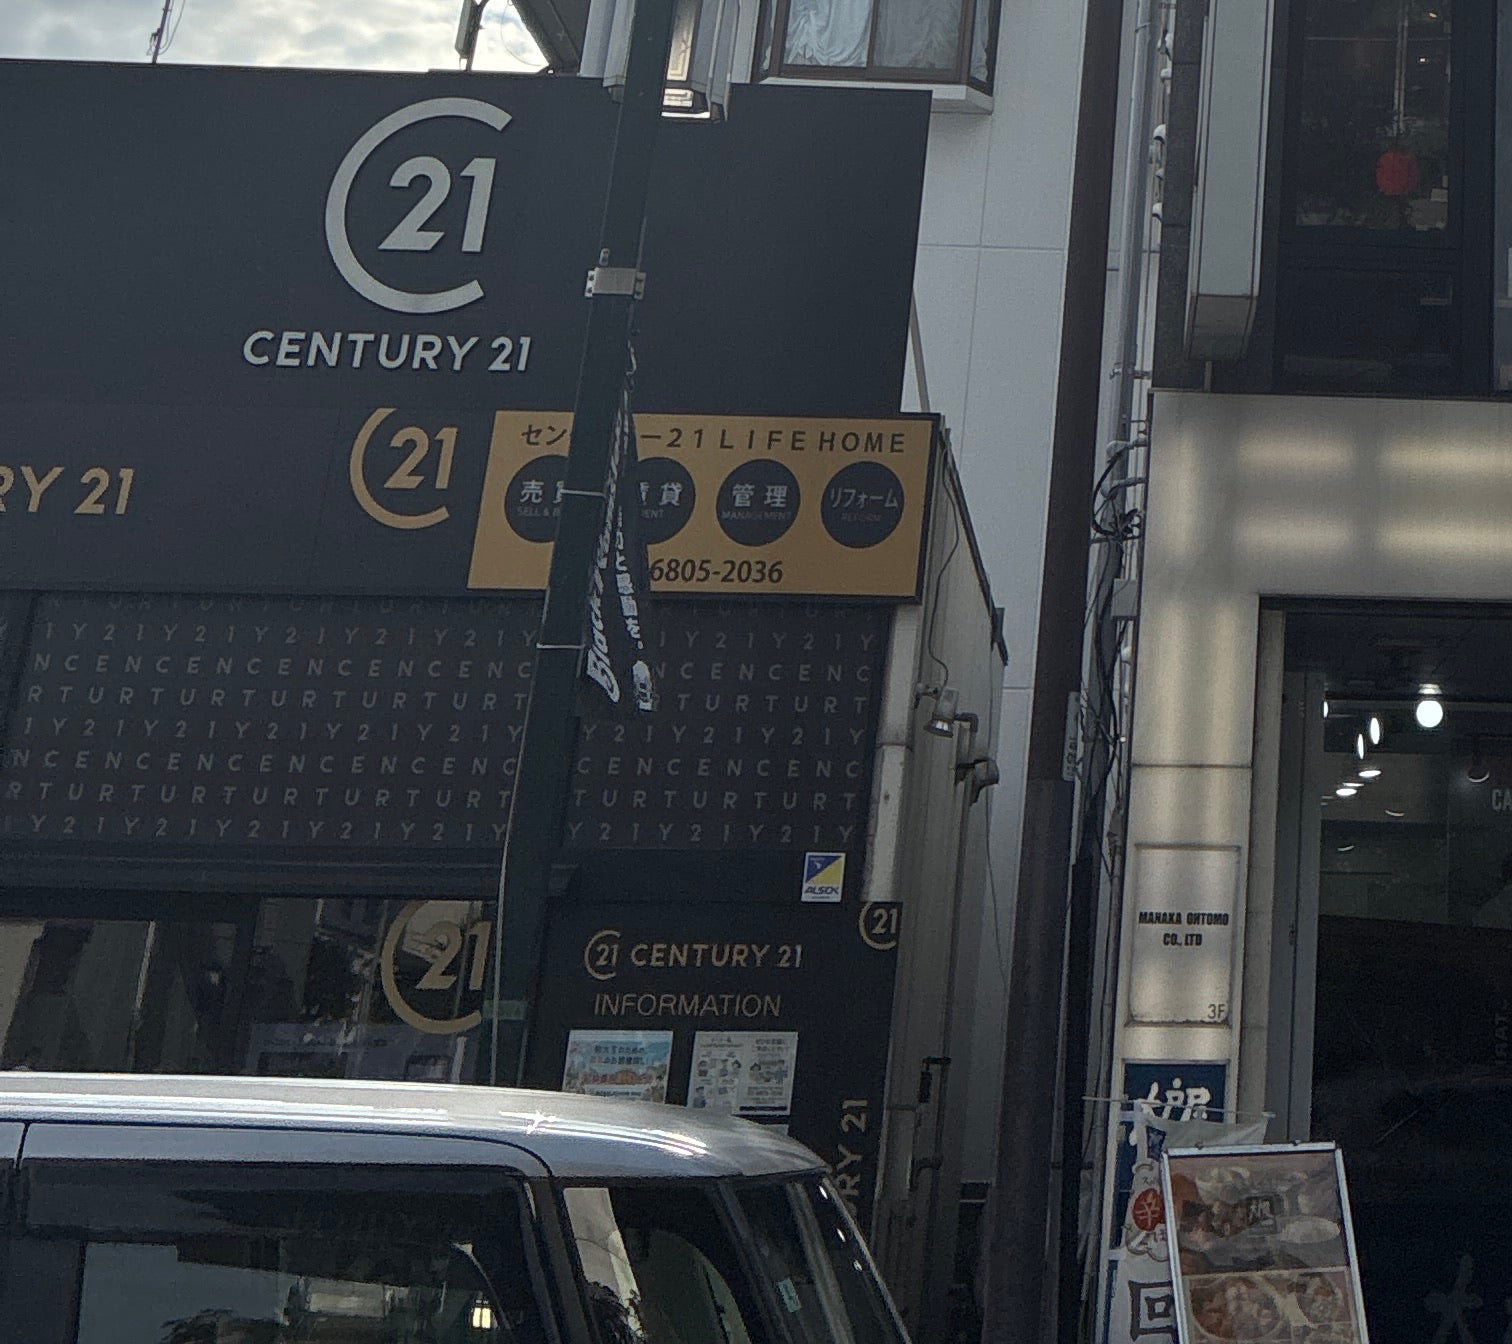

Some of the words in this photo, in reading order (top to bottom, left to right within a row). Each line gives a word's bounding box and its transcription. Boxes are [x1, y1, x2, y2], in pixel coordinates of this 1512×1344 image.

[242, 329, 479, 371] CENTURY
[487, 336, 532, 372] 21
[720, 428, 806, 451] LIFE
[818, 432, 906, 454] HOME
[74, 466, 135, 515] 21
[731, 483, 788, 508] 管理
[829, 488, 899, 510] リフォーム
[631, 943, 770, 969] CENTURY
[776, 944, 803, 969] 21
[594, 993, 782, 1018] INFORMATION
[1207, 1003, 1226, 1020] 3F
[838, 1098, 868, 1133] 21
